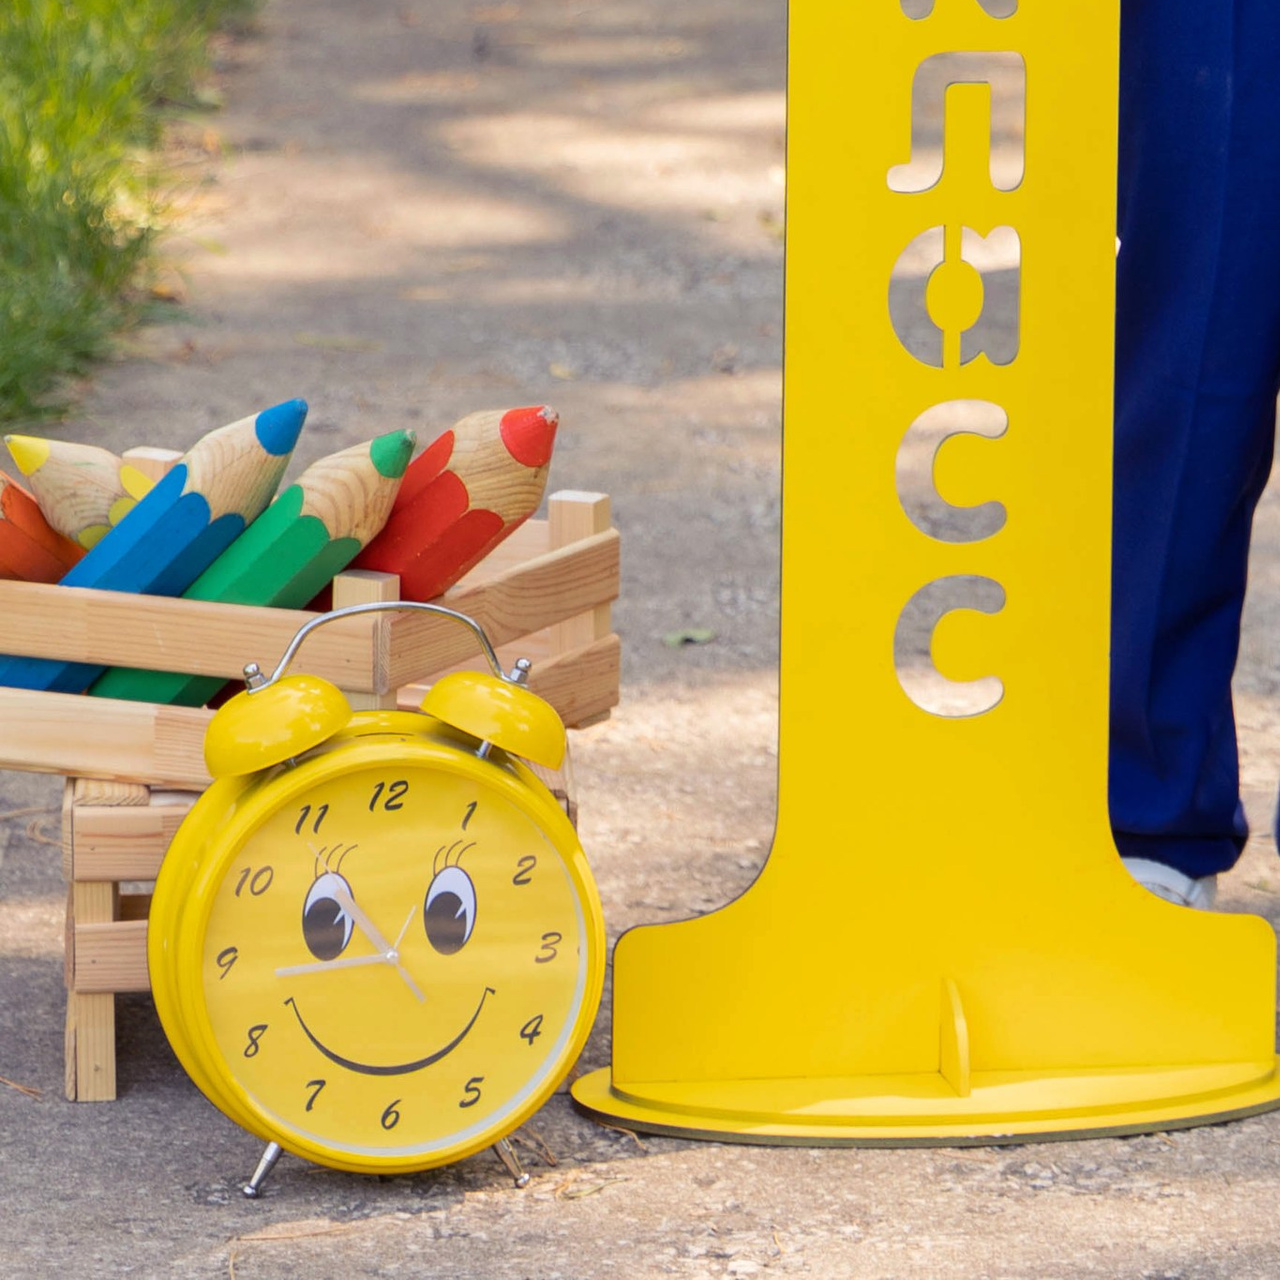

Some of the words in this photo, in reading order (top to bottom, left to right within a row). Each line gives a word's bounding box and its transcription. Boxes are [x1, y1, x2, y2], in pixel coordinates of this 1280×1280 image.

[368, 779, 410, 813] 12
[294, 803, 330, 835] 11
[461, 800, 478, 831] 1
[234, 865, 274, 897] 10
[511, 854, 538, 886] 2
[215, 946, 239, 980] 9
[533, 930, 563, 965] 3
[243, 1023, 269, 1059] 8
[519, 1013, 544, 1047] 4
[305, 1078, 327, 1113] 7
[458, 1076, 485, 1109] 5
[380, 1098, 402, 1131] 6
